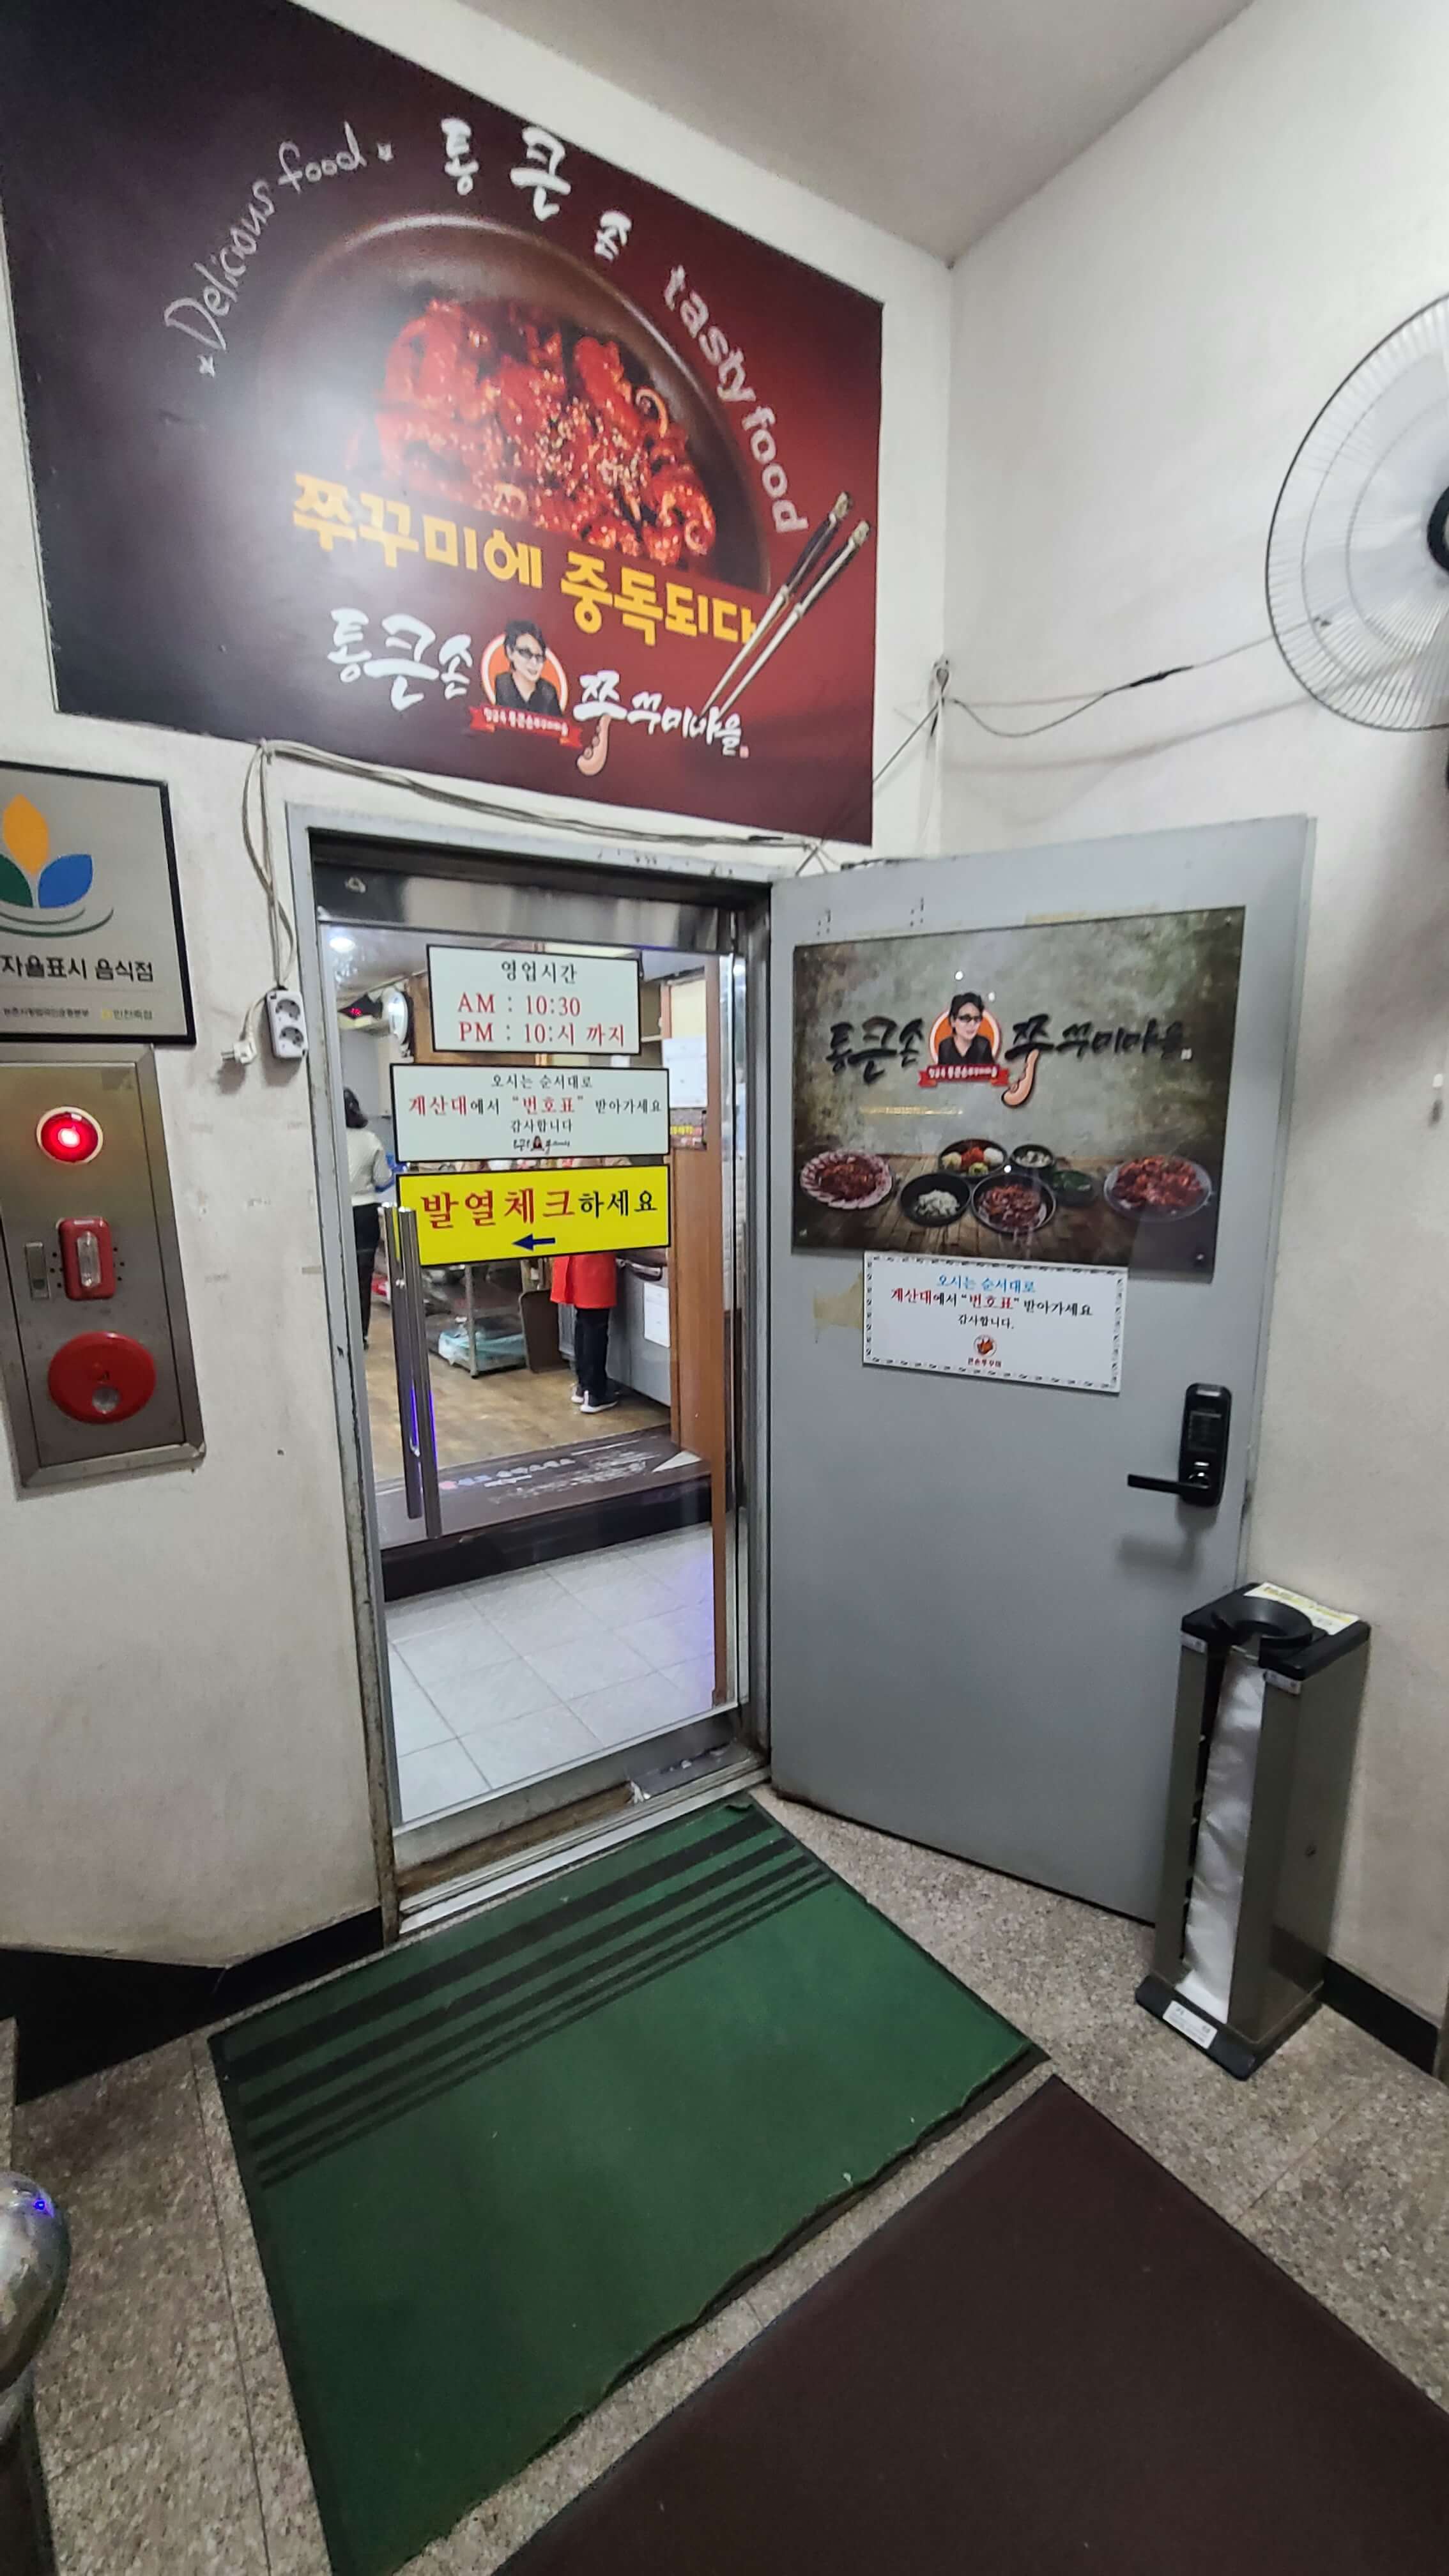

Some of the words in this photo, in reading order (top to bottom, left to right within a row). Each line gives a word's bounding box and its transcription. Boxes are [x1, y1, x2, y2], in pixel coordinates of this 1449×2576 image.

[164, 180, 275, 353] Delicious
[279, 121, 367, 193] food
[664, 264, 756, 404] tasty
[742, 405, 809, 533] food
[293, 473, 543, 589] 쭈꾸미에
[561, 553, 758, 647] 중독되다
[326, 608, 473, 711] 통큰손
[0, 954, 88, 979] 자율표시
[95, 958, 154, 983] 음식점
[502, 960, 578, 985] 영업시간
[457, 992, 495, 1014] AM
[525, 995, 581, 1017] 10:30
[459, 1022, 494, 1042] PM
[525, 1023, 575, 1046] 10:시
[586, 1024, 625, 1047] 까지
[491, 1074, 533, 1089] 오시는
[540, 1075, 593, 1090] 순서대로
[408, 1095, 500, 1117] 계산대에서
[595, 1098, 662, 1115] 받아가세요
[511, 1119, 573, 1134] 감사합니다
[421, 1188, 658, 1230] 발열체크하세요
[937, 1275, 976, 1290] 오시는
[981, 1278, 1036, 1294] 순서대로
[891, 1287, 958, 1307] 계산대에서
[1023, 1300, 1094, 1317] 받아가세요
